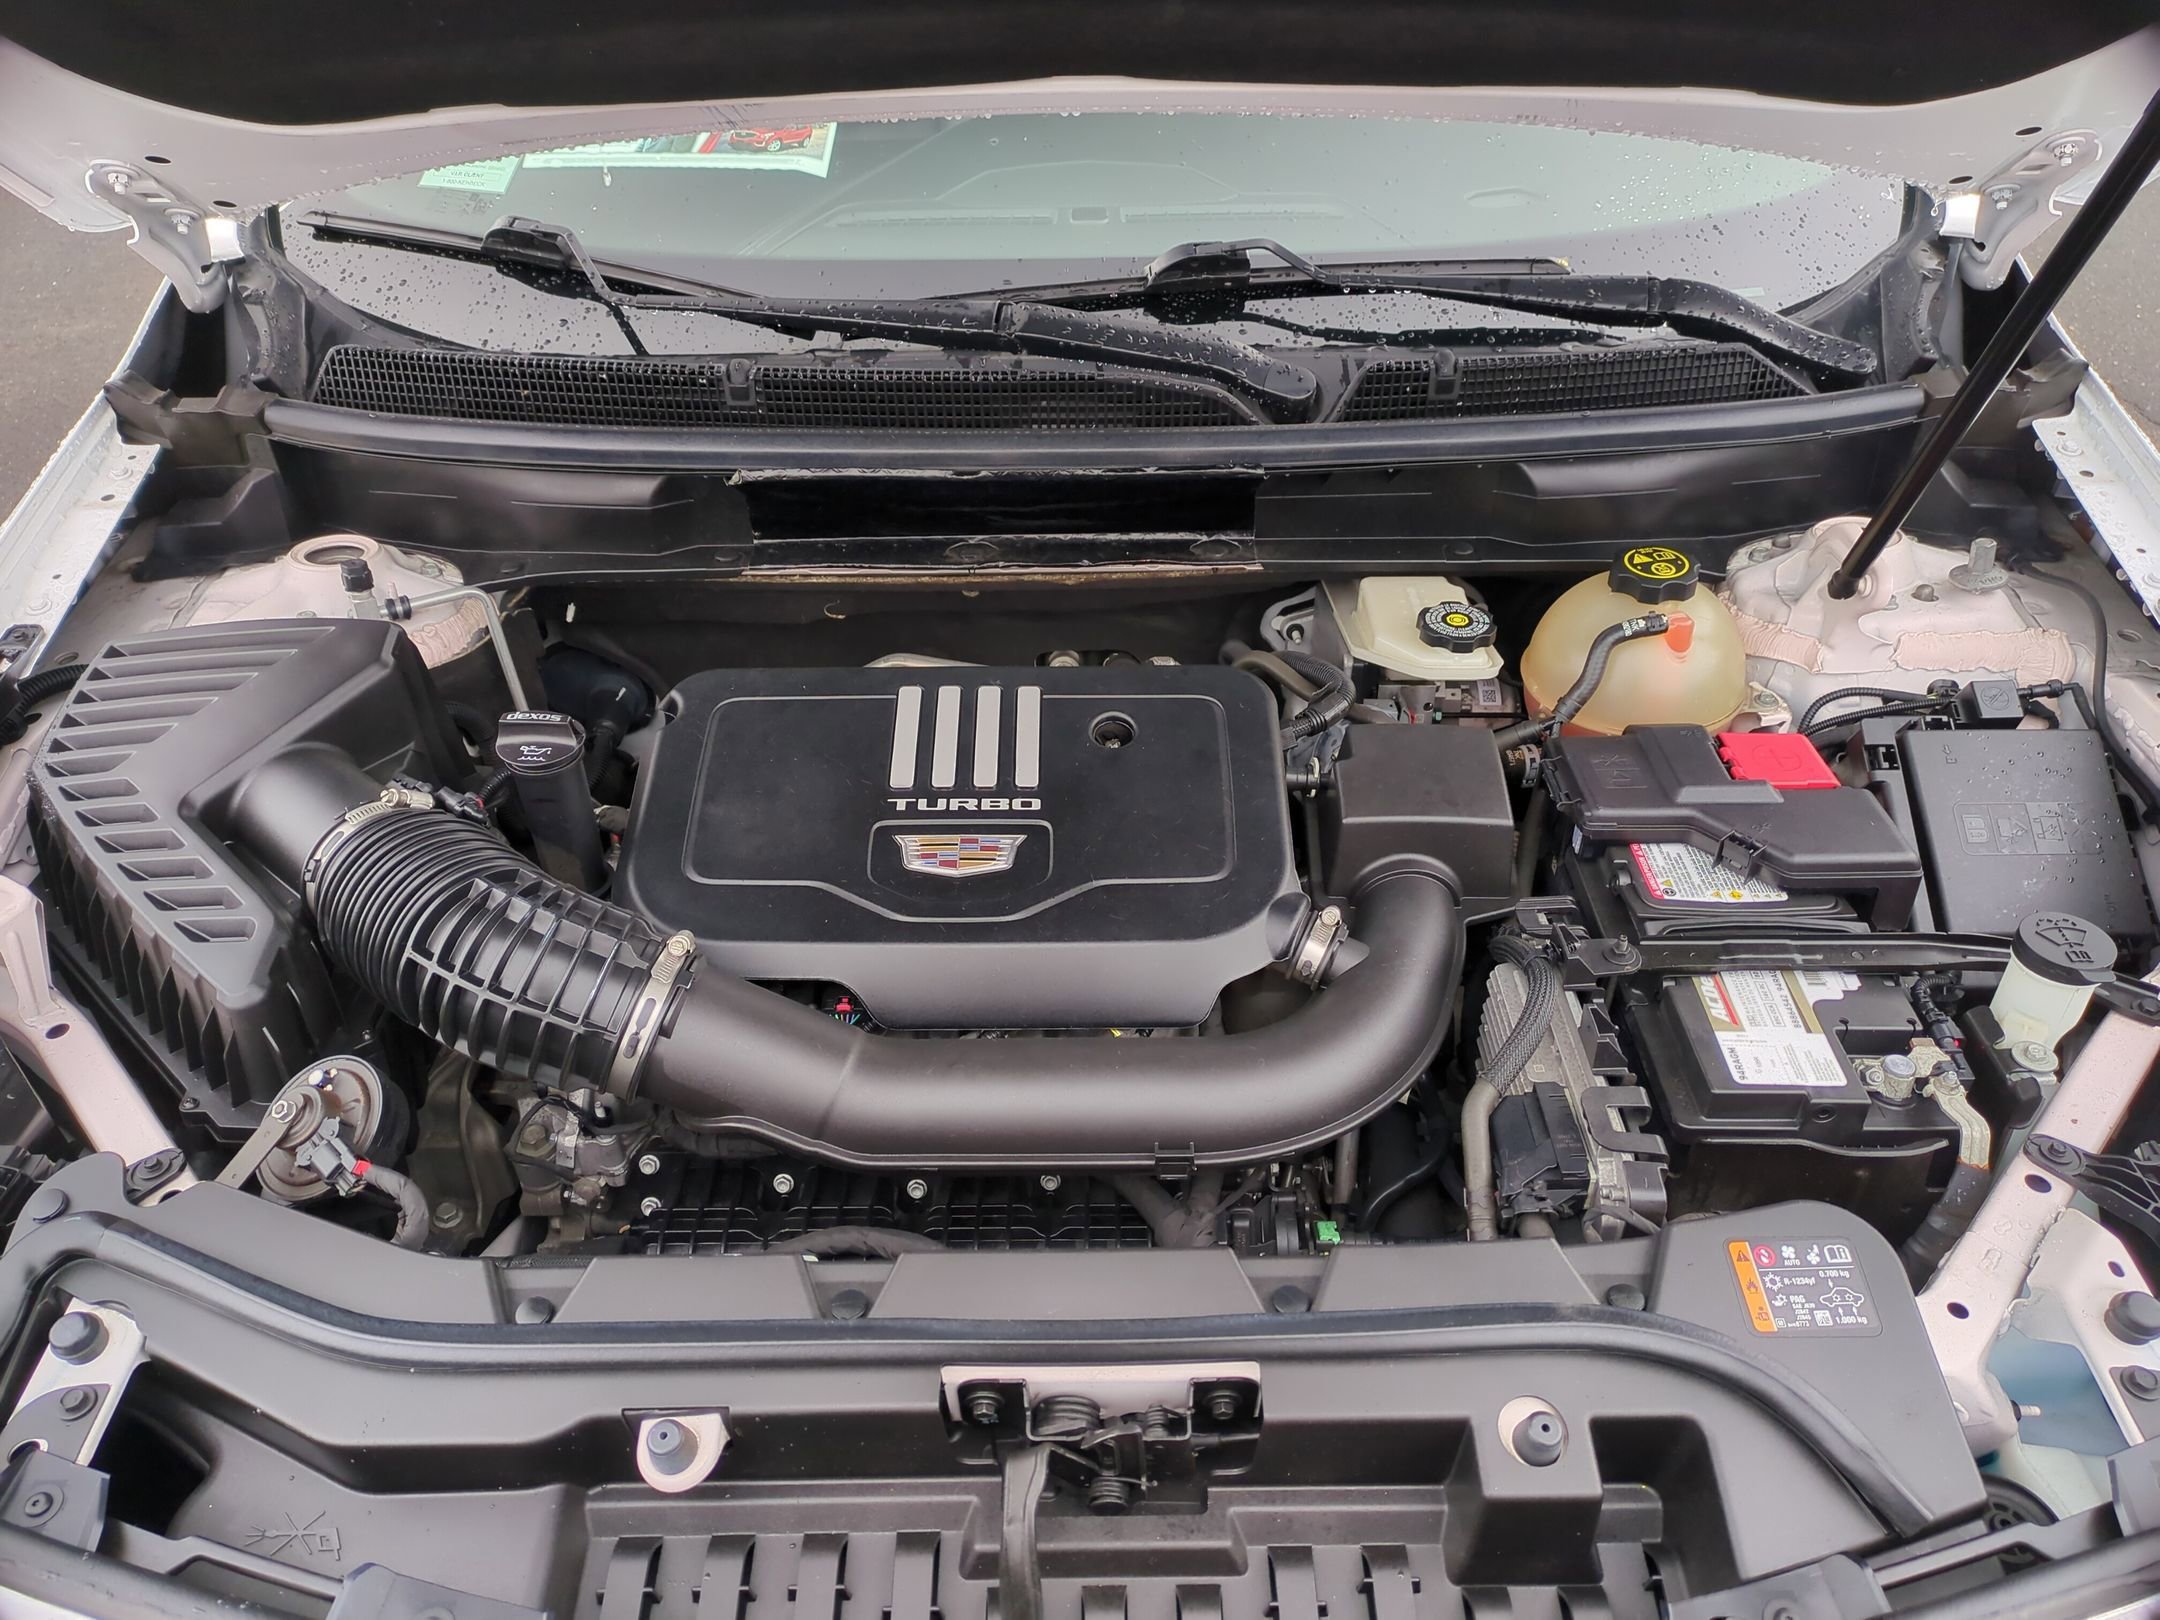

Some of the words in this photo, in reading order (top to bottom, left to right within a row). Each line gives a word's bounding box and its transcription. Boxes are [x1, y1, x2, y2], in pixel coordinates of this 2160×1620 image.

[506, 711, 562, 722] dexos
[887, 798, 1042, 811] TURBO
[1818, 1270, 1838, 1278] 0.700
[1839, 1269, 1850, 1279] kg
[1783, 1277, 1816, 1286] R-1234yf
[1789, 1295, 1806, 1303] PAG
[1857, 1316, 1868, 1325] kg
